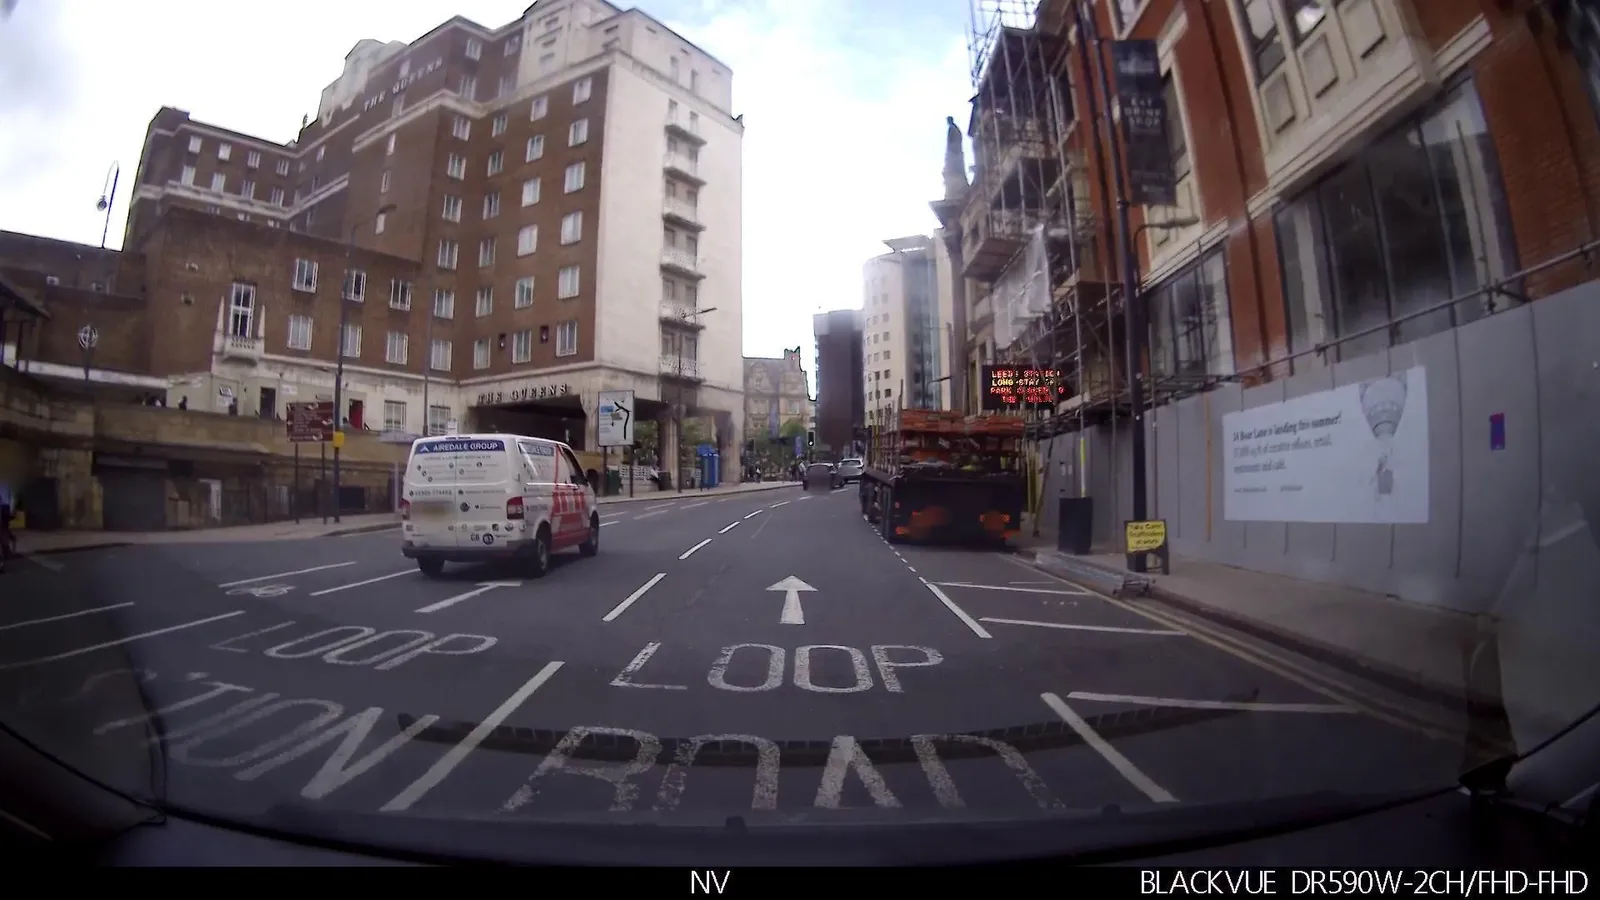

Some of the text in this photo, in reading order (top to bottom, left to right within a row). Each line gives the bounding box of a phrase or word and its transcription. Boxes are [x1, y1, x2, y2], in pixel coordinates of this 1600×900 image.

[364, 56, 443, 112] THE QUEENS
[478, 383, 569, 404] THE QUEENS
[433, 442, 498, 452] AIREDALE GROUP
[1254, 428, 1267, 439] Lane
[1274, 421, 1297, 435] landing
[209, 620, 497, 670] LOOP
[611, 641, 944, 692] LOOP
